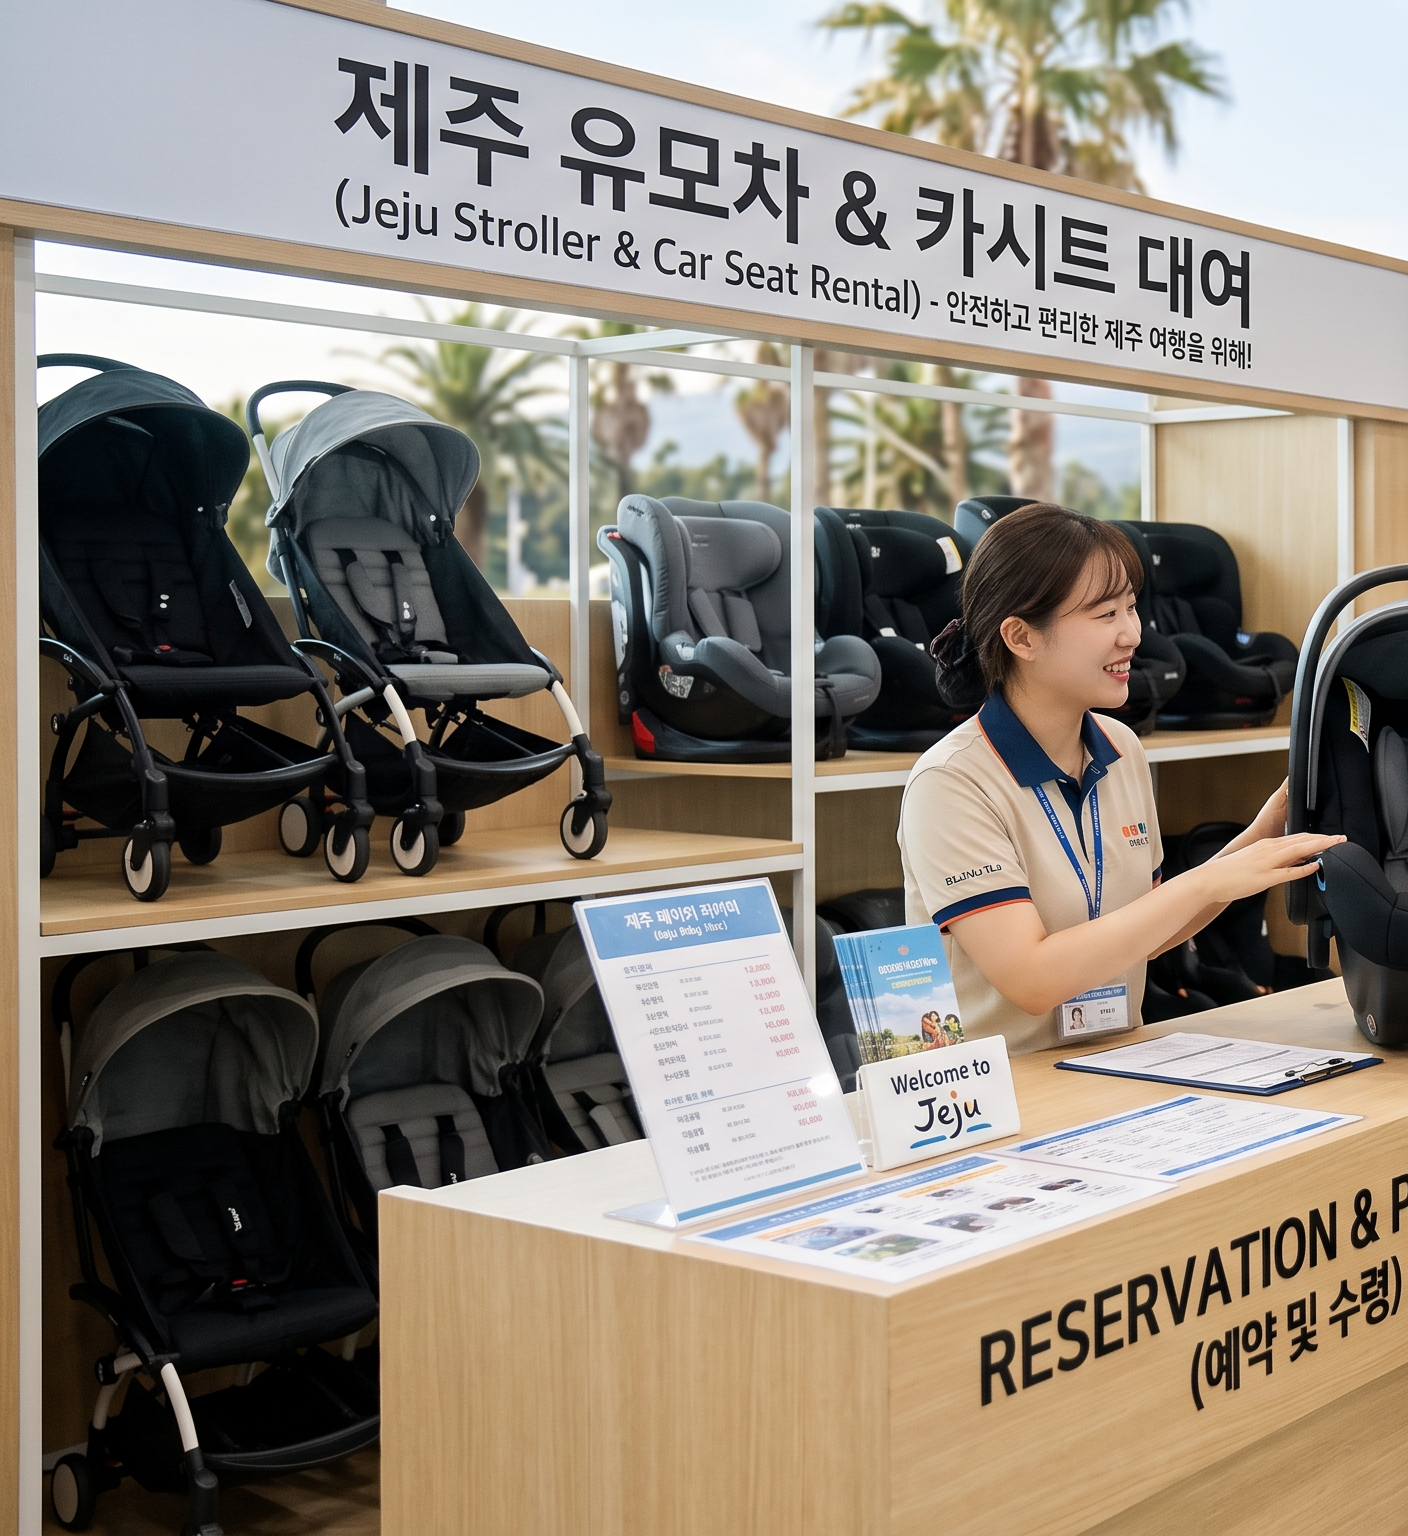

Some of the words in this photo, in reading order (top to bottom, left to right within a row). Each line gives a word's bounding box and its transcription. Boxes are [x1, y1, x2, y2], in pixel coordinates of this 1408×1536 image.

[334, 57, 529, 187] 제주
[560, 107, 809, 244] 유모차
[835, 171, 891, 250] &
[916, 187, 1116, 294] 카시트
[1138, 235, 1251, 330] 대여
[336, 178, 438, 240] (Jeju
[454, 202, 600, 262] Stroller
[613, 230, 641, 269] &
[653, 237, 713, 280] Car
[725, 250, 799, 295] Seat
[811, 264, 921, 320] Rental)
[946, 291, 1031, 332] 안전하고
[1038, 306, 1098, 346] 편리한
[1104, 319, 1143, 353] 제주
[1149, 326, 1205, 364] 여행을
[1210, 336, 1253, 369] 위해!
[890, 1064, 969, 1095] Welcome
[972, 1059, 990, 1076] to
[914, 1090, 982, 1139] Jeju
[980, 1202, 1337, 1406] RESERVATION
[1350, 1188, 1380, 1250] &
[1190, 1311, 1277, 1411] (예약
[1287, 1291, 1318, 1362] 및
[1328, 1255, 1402, 1338] 수령)
